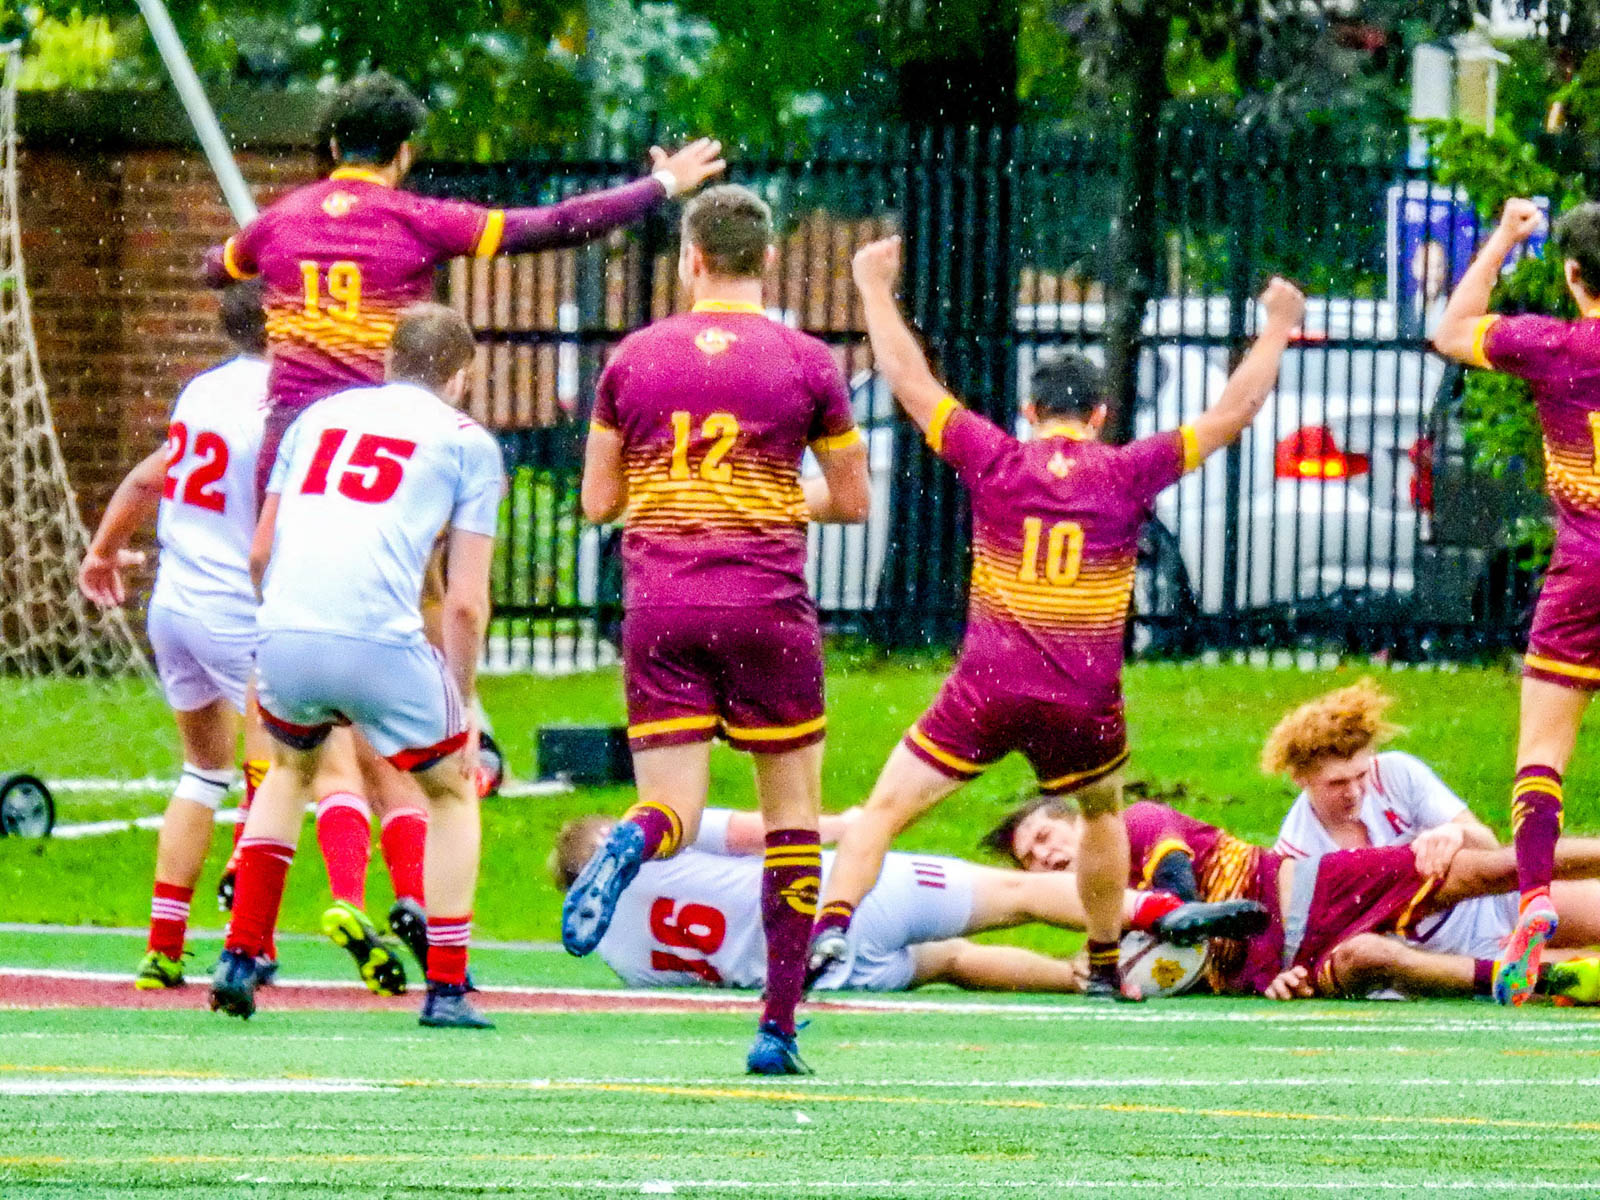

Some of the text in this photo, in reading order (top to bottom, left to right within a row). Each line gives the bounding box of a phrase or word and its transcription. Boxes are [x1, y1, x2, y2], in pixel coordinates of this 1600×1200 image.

[299, 260, 361, 320] 19
[162, 421, 229, 514] 22
[299, 428, 417, 504] 15
[669, 411, 739, 483] 12
[1017, 516, 1084, 586] 10
[650, 897, 726, 982] 16
